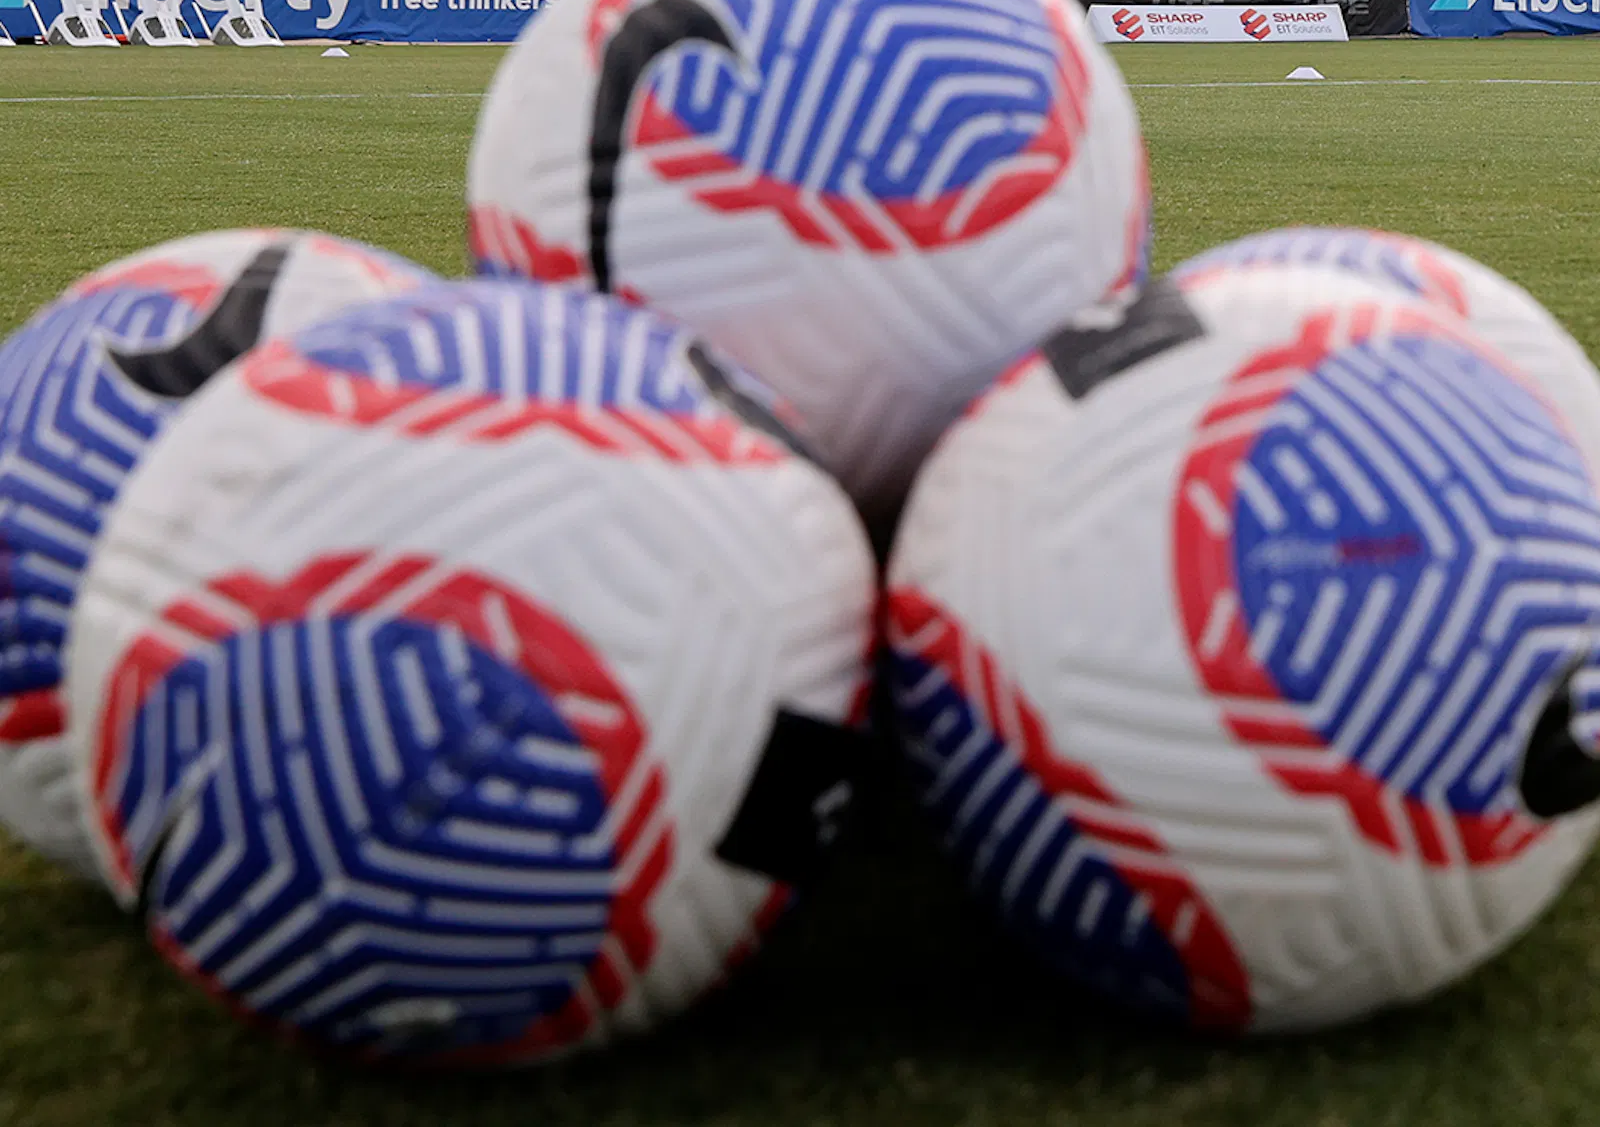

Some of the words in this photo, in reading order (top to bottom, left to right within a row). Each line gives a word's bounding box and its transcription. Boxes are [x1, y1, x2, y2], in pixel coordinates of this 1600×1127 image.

[1147, 13, 1205, 24] SHARP
[1273, 12, 1328, 23] SHARP
[1150, 25, 1165, 35] EIT
[1166, 26, 1209, 36] Solutions
[1277, 24, 1291, 34] EIT
[1292, 24, 1333, 35] Solutions
